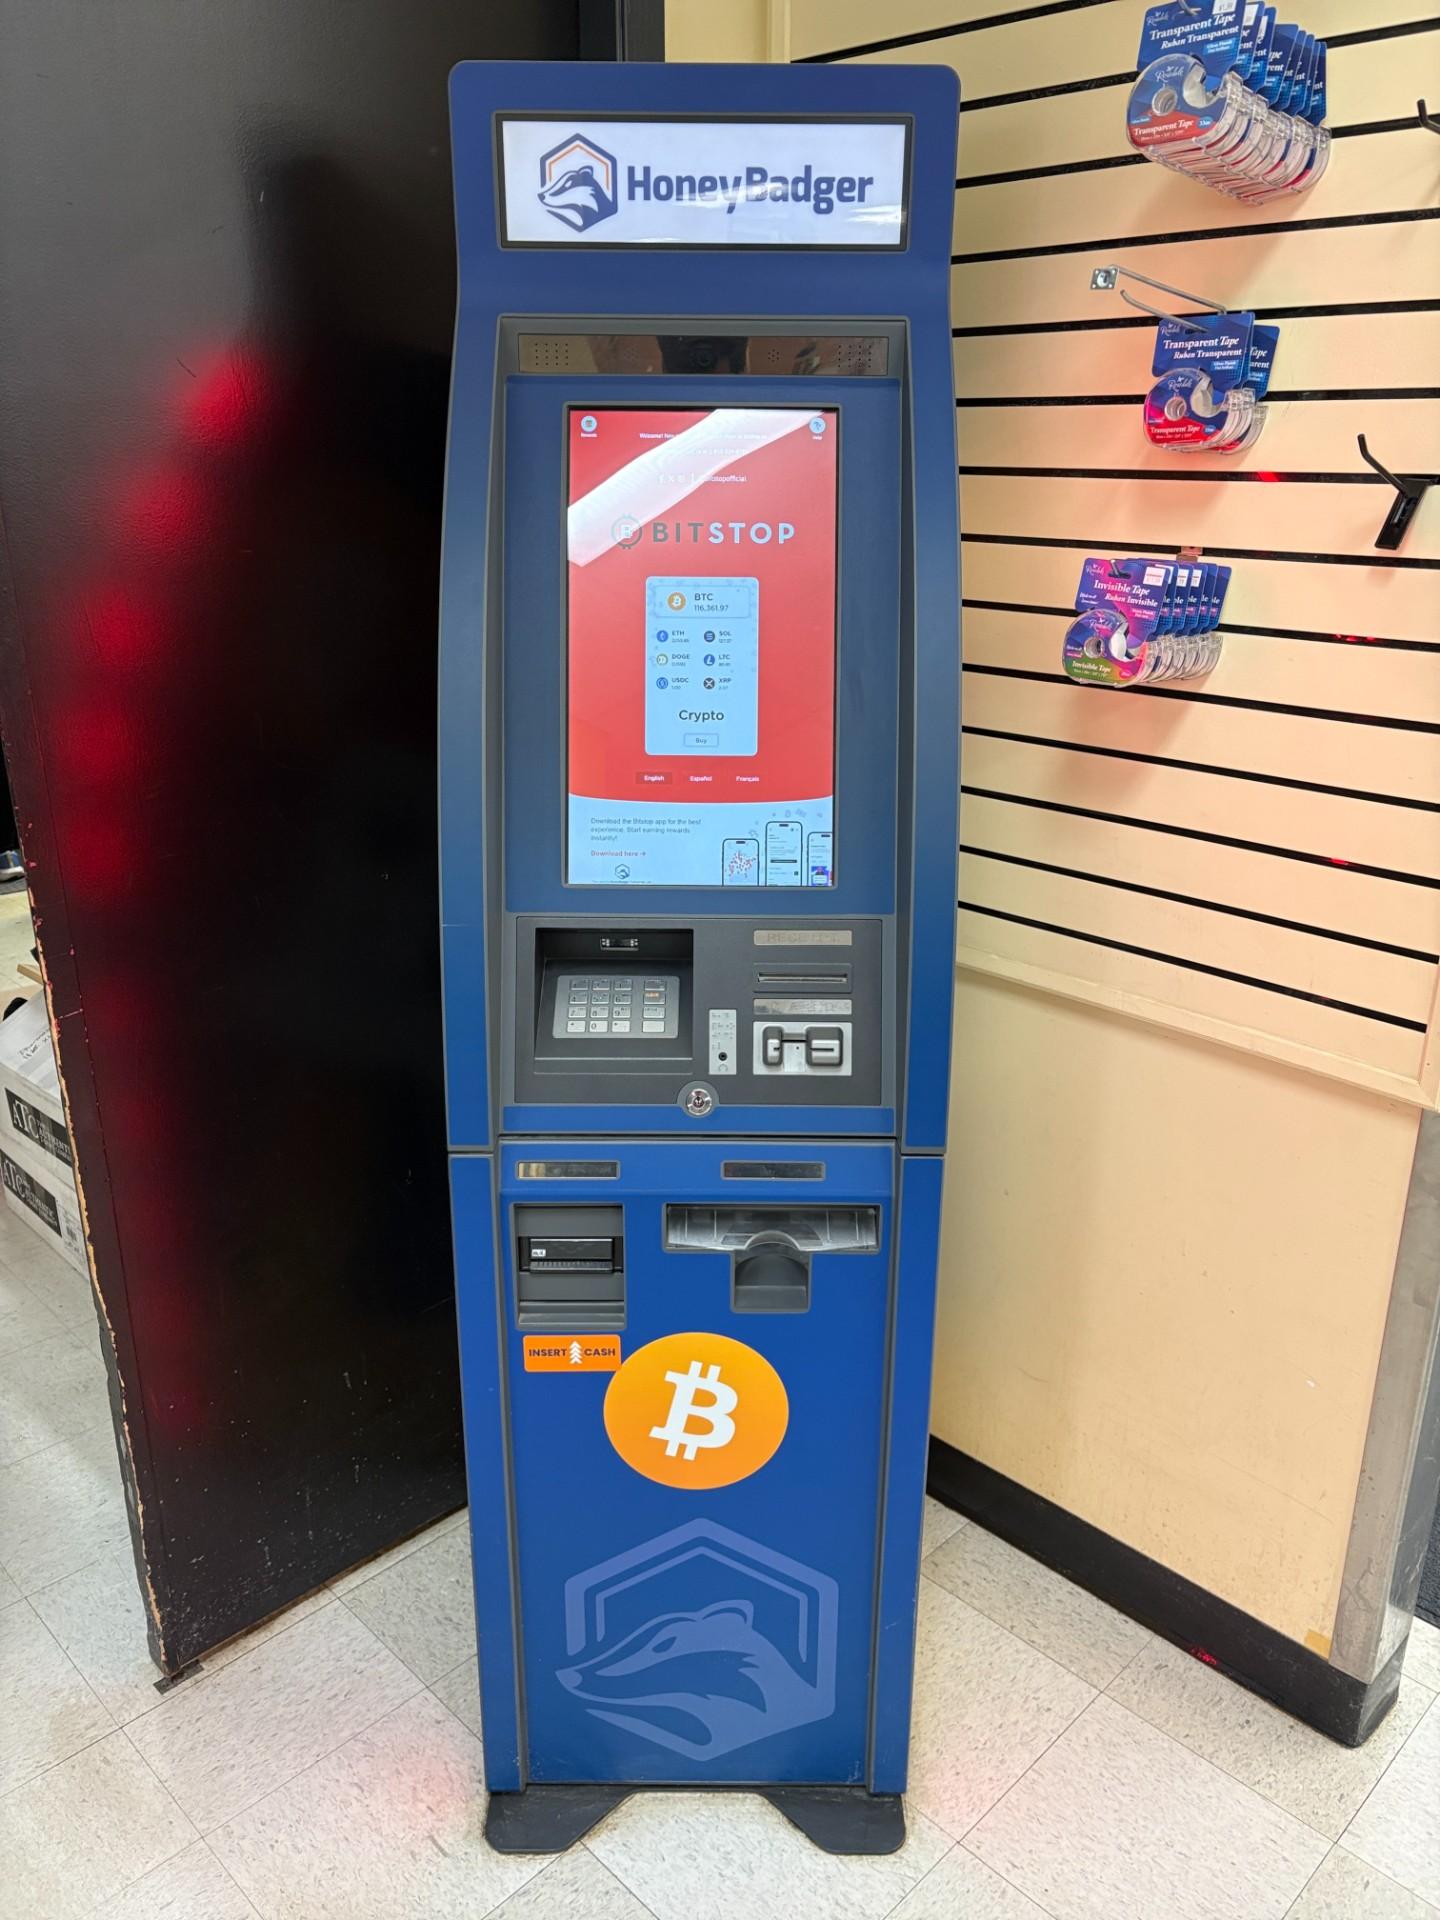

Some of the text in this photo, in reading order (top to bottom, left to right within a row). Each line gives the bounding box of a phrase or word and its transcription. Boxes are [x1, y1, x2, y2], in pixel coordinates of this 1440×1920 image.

[1150, 18, 1212, 40] Transparent
[1214, 14, 1236, 26] Tape
[1186, 26, 1239, 43] Transparent
[1134, 122, 1178, 136] Transparent
[1178, 120, 1196, 129] Tape
[627, 164, 874, 214] HoneyBadger
[1163, 336, 1240, 351] Transparent Tape
[1173, 348, 1242, 360] Ruban Transparent
[1151, 426, 1187, 434] Transparent
[652, 522, 795, 544] BITSTOP
[1094, 580, 1150, 596] Invisible Tape
[1104, 592, 1126, 602] Ruban
[1127, 596, 1158, 608] Invisible
[678, 710, 724, 722] Crypto
[528, 1348, 616, 1357] INSERT CASH
